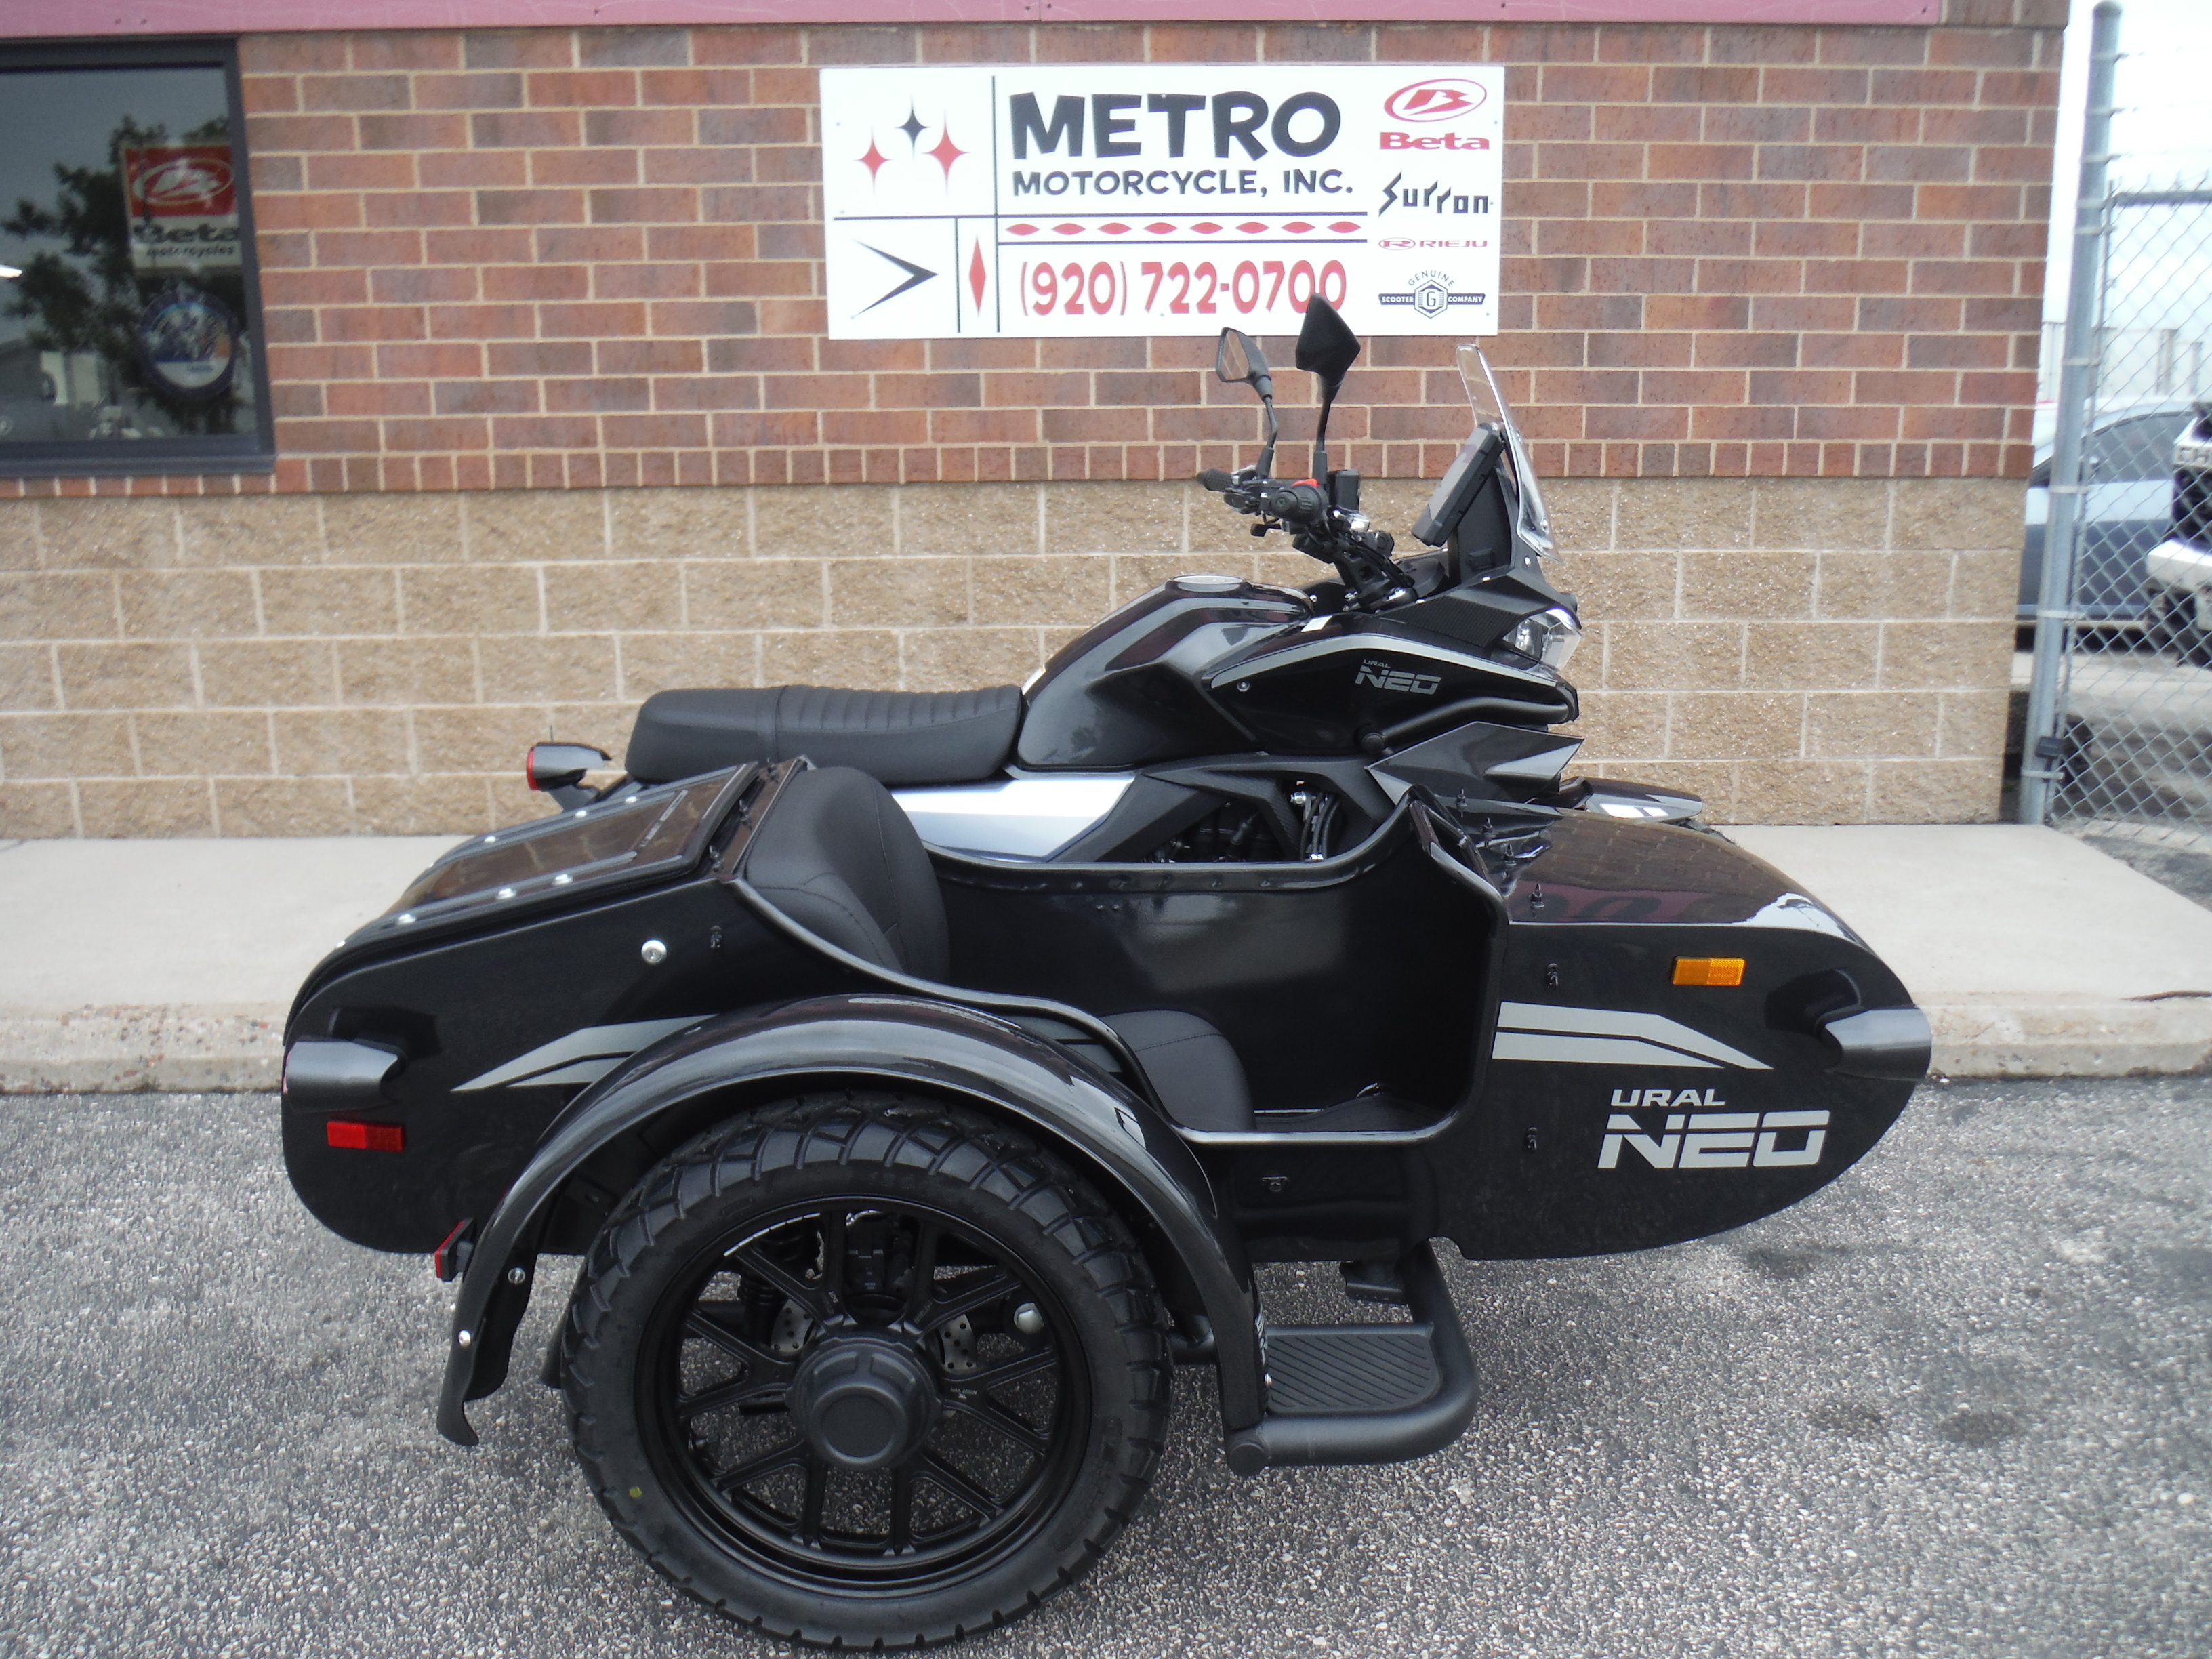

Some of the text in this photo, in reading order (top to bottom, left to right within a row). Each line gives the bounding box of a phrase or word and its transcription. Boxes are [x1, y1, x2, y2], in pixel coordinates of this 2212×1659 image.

[1009, 91, 1342, 162] METRO
[1380, 131, 1490, 150] Beta
[1012, 169, 1353, 198] MOTORCYCLE, INC.
[1378, 170, 1489, 218] Surron
[1419, 240, 1488, 248] RIEJU
[1020, 259, 1347, 316] (920) 722-0700
[1408, 270, 1455, 287] GENUINE
[1427, 291, 1437, 307] G
[1363, 659, 1391, 668] URAL
[1355, 665, 1441, 695] NEO
[1610, 1088, 1726, 1107] URAL
[1597, 1109, 1830, 1169] NEO
